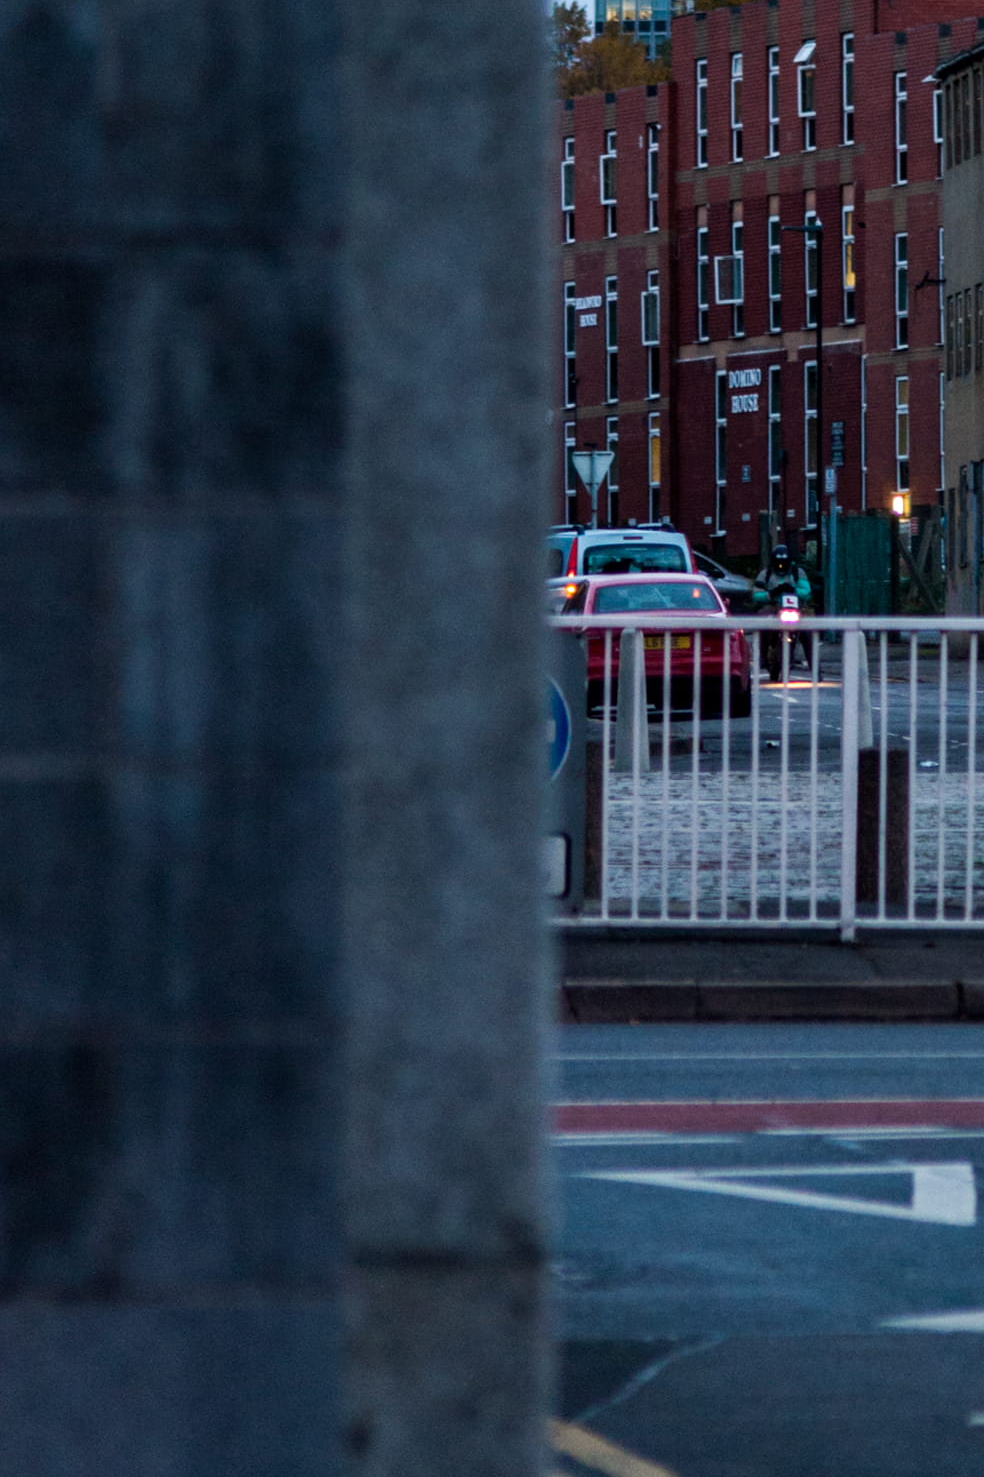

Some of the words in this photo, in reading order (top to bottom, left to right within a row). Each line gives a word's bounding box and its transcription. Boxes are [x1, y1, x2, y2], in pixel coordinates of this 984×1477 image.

[729, 368, 762, 389] DOMINO
[731, 393, 759, 413] HOUSE
[786, 597, 795, 605] L
